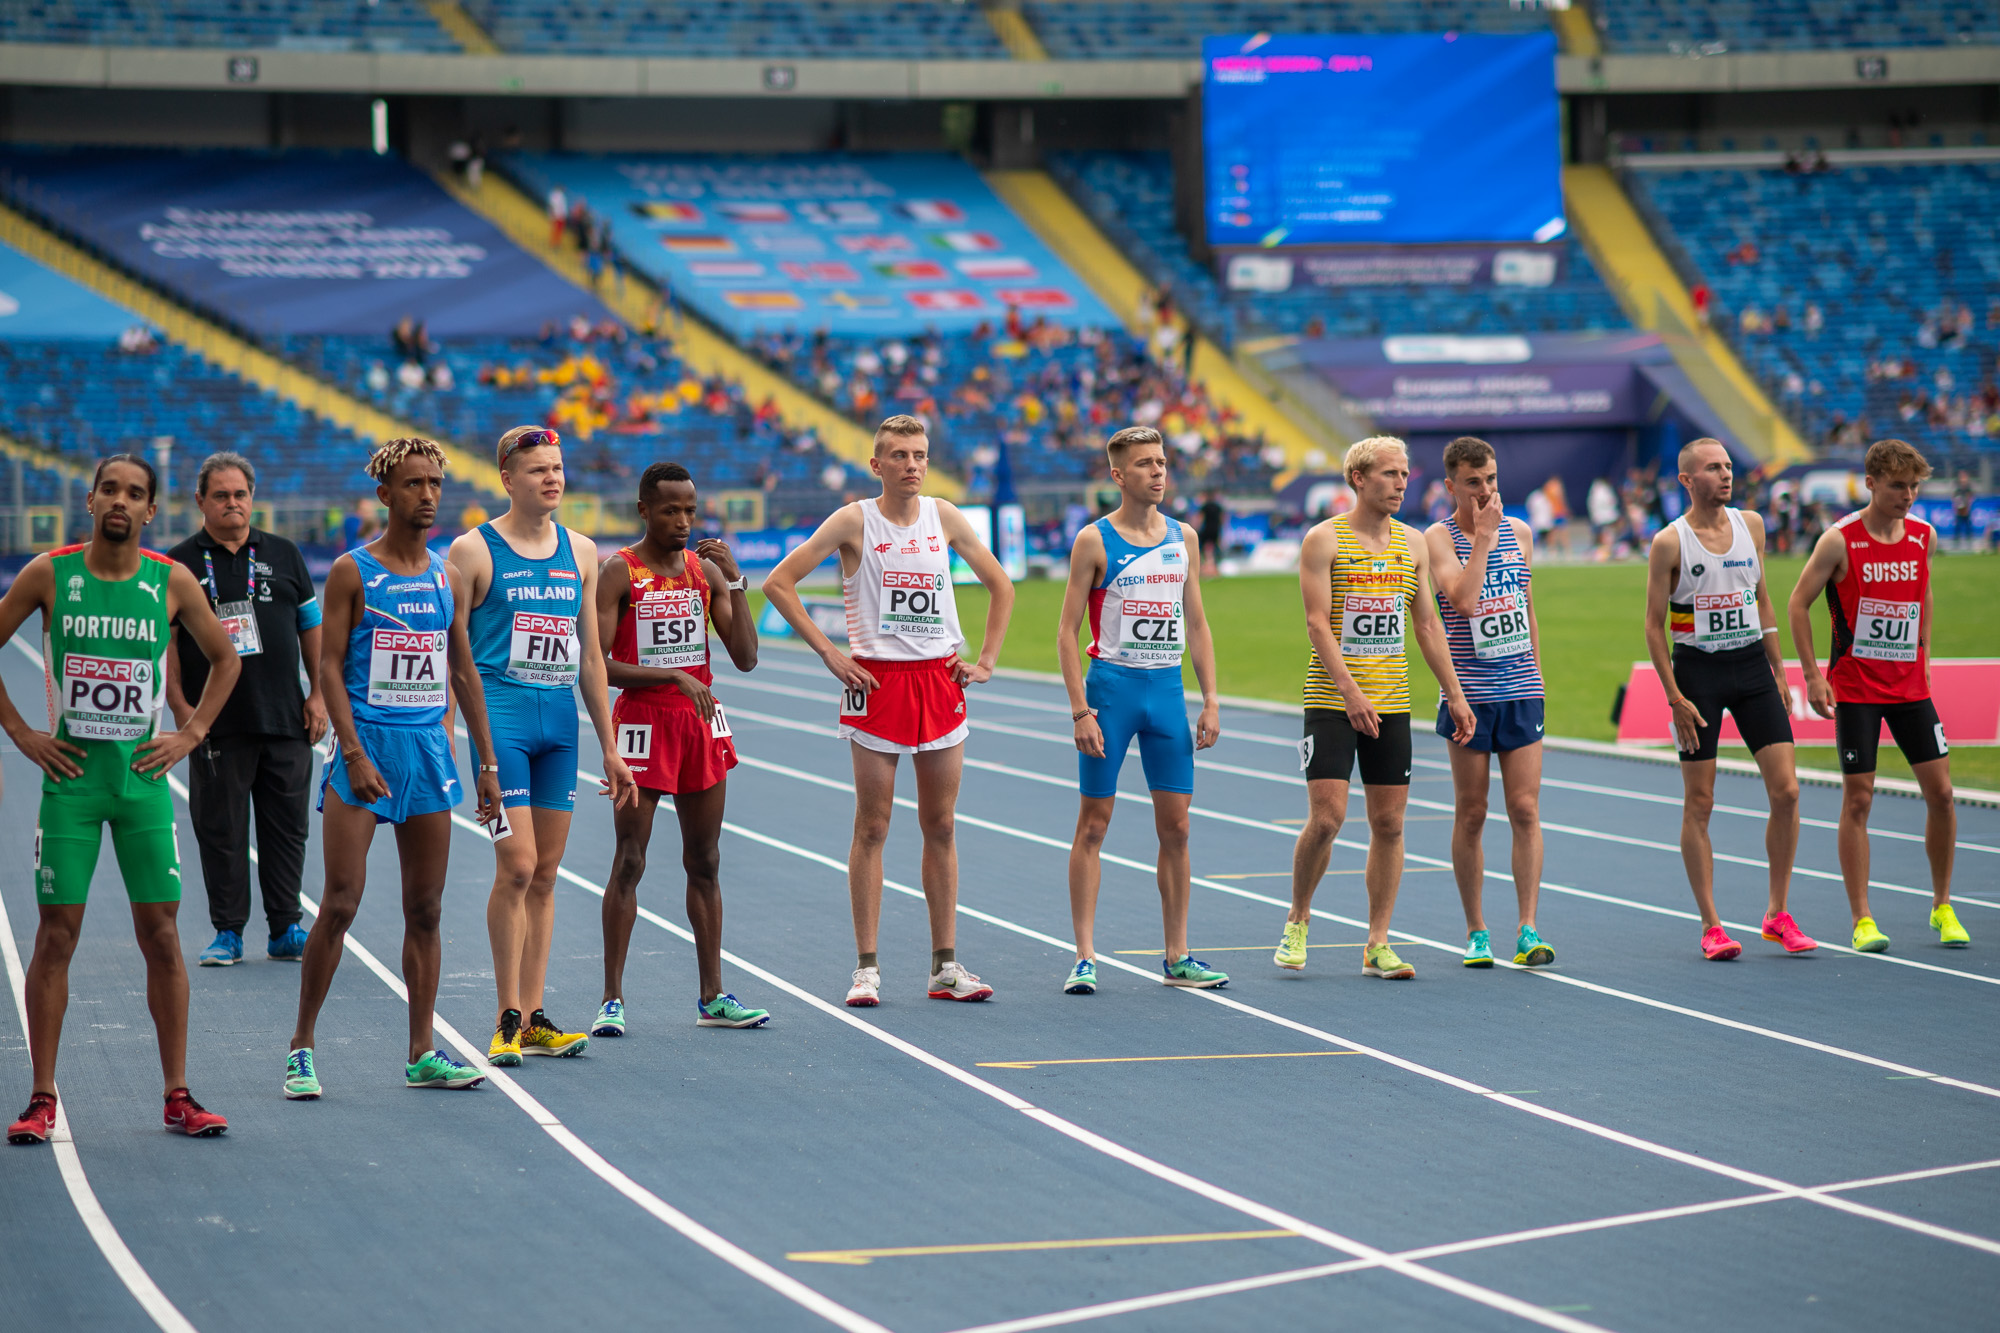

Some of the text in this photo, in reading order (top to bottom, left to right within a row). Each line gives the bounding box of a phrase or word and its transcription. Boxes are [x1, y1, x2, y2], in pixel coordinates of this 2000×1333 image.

[1723, 560, 1746, 568] Allianz
[885, 574, 933, 587] SPAR
[1117, 574, 1183, 587] CZECH REPUBLIC
[1346, 573, 1403, 584] GERMANY
[1484, 569, 1520, 585] REAT
[506, 586, 576, 602] FINLAND
[642, 588, 700, 600] ESPAÑA
[1481, 583, 1520, 600] RITAIN
[398, 603, 436, 614] ITALIA
[891, 590, 939, 615] POL
[1124, 602, 1171, 616] SPAR
[1347, 598, 1394, 611] SPAR
[1474, 597, 1515, 616] SPAR
[1697, 595, 1742, 608] SPAR
[1861, 602, 1907, 617] SPAR
[639, 602, 689, 618] SPAR
[62, 615, 158, 642] PORTUGAL
[516, 616, 568, 633] SPAR
[901, 625, 929, 633] SILESIA
[1353, 614, 1400, 636] GER
[1480, 611, 1527, 638] GBR
[1709, 609, 1750, 633] BEL
[652, 619, 696, 645] ESP
[1132, 619, 1178, 641] CZE
[1869, 619, 1909, 641] SUI
[376, 634, 433, 650] SPAR
[527, 635, 569, 662] FIN
[1497, 644, 1521, 654] SILESIA
[390, 654, 435, 680] ITA
[663, 656, 691, 664] SILESIA
[67, 659, 130, 680] SPAR
[530, 672, 558, 681] SILESIA
[70, 680, 144, 714] POR
[396, 694, 426, 702] SILESIA
[428, 694, 444, 702] 2023
[844, 688, 865, 712] 10
[80, 713, 101, 721] RUN
[102, 714, 130, 724] CLEAN
[715, 709, 726, 732] 11
[84, 725, 122, 736] SILESIA
[124, 728, 146, 737] 2023
[626, 730, 645, 753] 11
